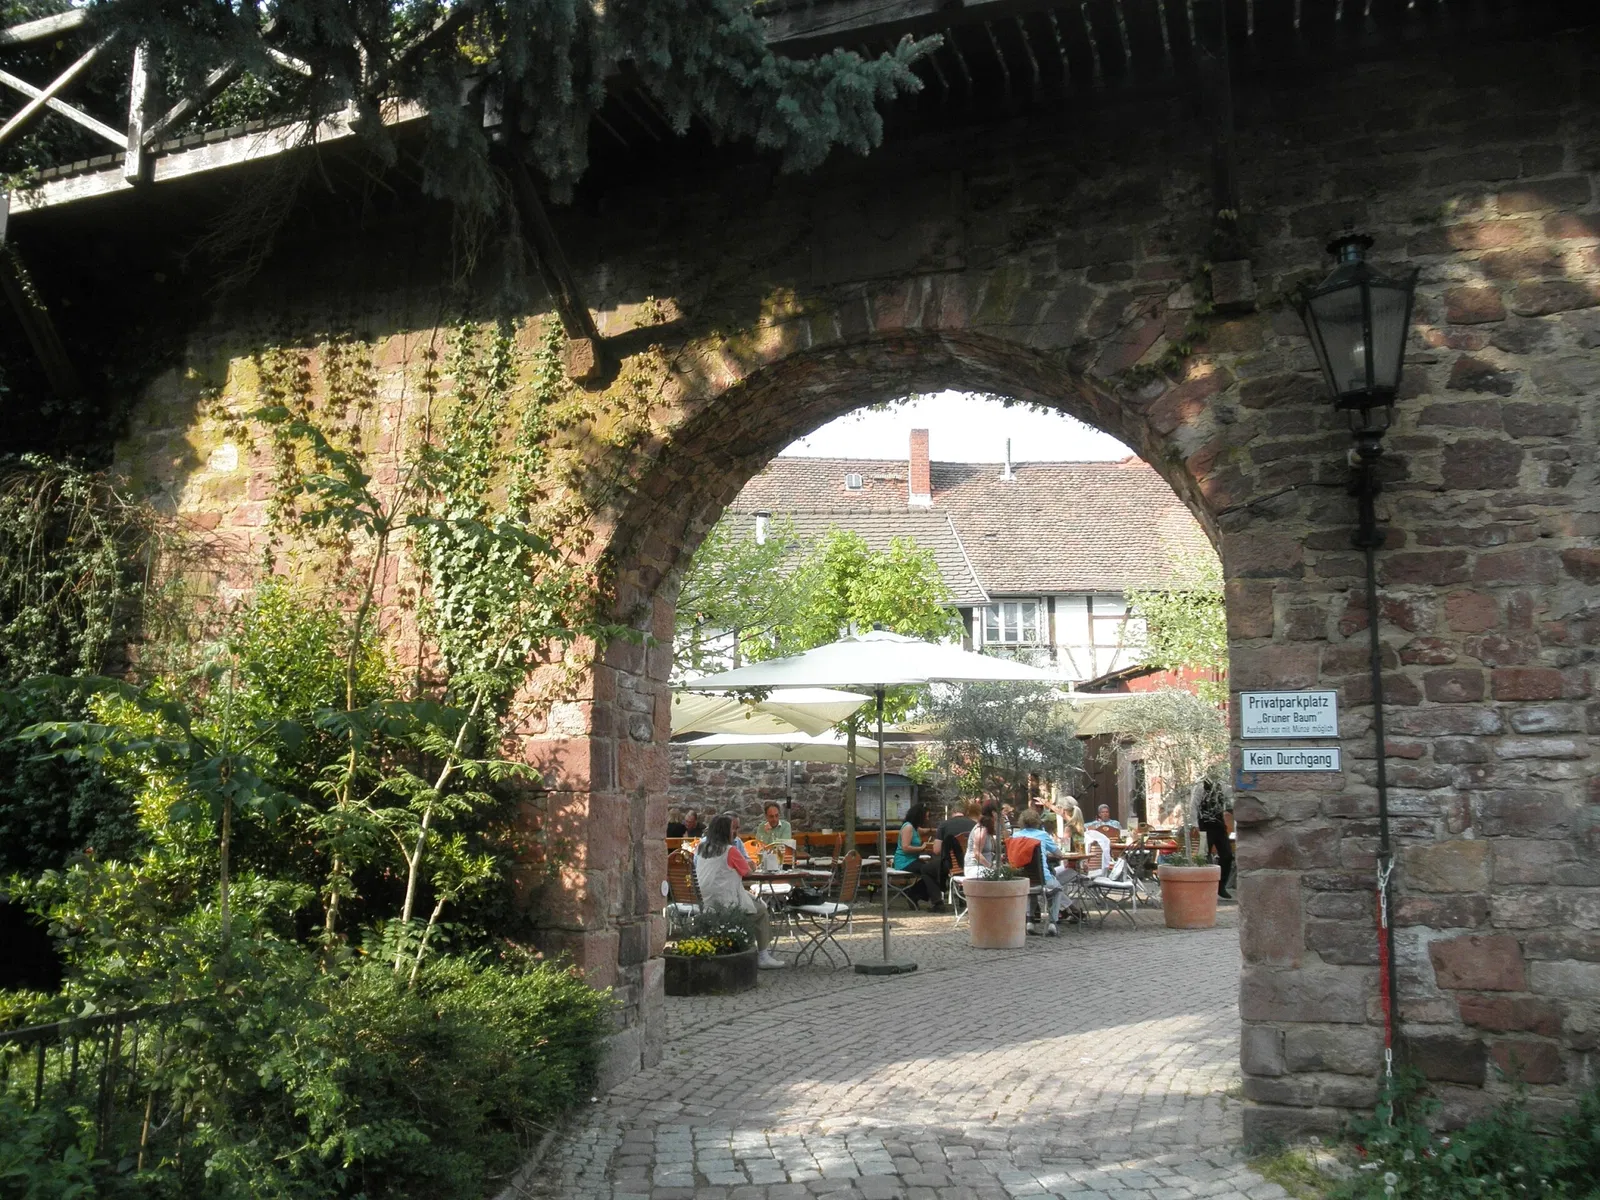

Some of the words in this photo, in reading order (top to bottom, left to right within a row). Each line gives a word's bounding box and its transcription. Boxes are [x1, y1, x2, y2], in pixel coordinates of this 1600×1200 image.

[1249, 696, 1329, 711] Privatparkplatz
[1250, 752, 1272, 765] Kein
[1277, 752, 1332, 768] Durchgang
